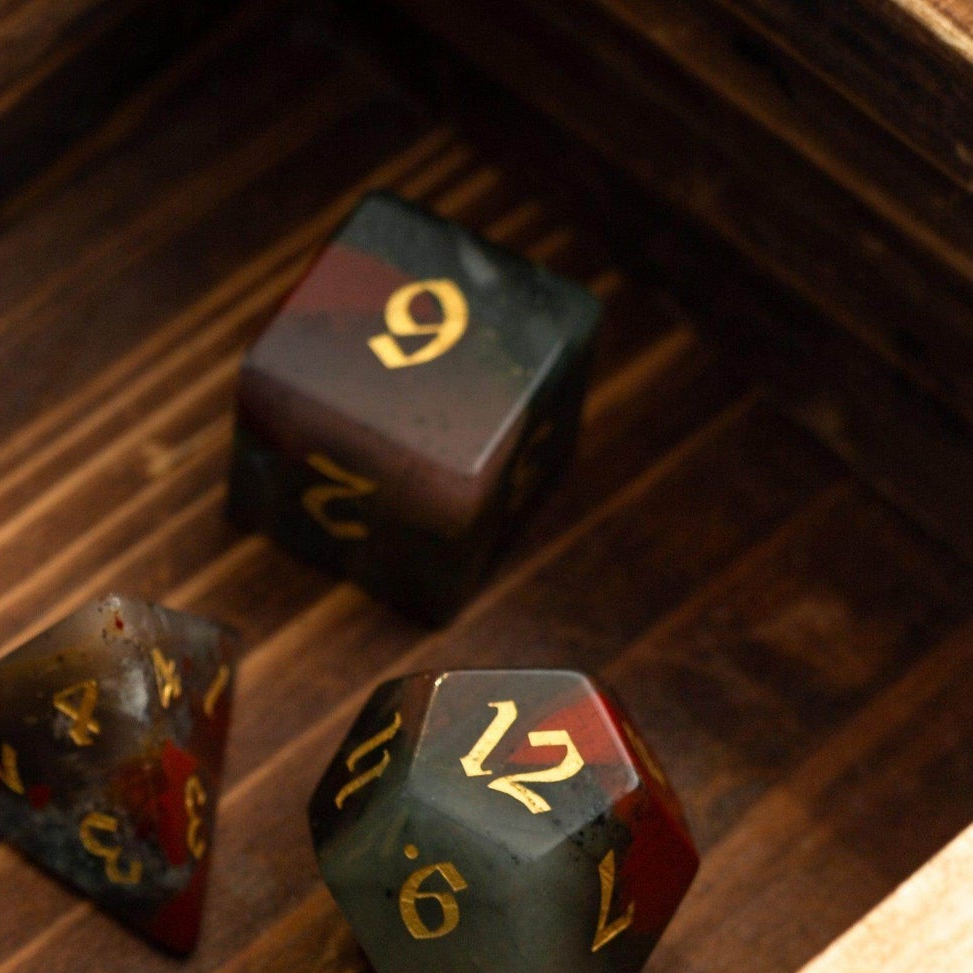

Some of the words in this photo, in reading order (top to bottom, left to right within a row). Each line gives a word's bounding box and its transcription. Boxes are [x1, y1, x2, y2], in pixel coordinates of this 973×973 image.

[52, 678, 101, 746] 4
[459, 700, 585, 815] 12
[80, 811, 143, 885] 3
